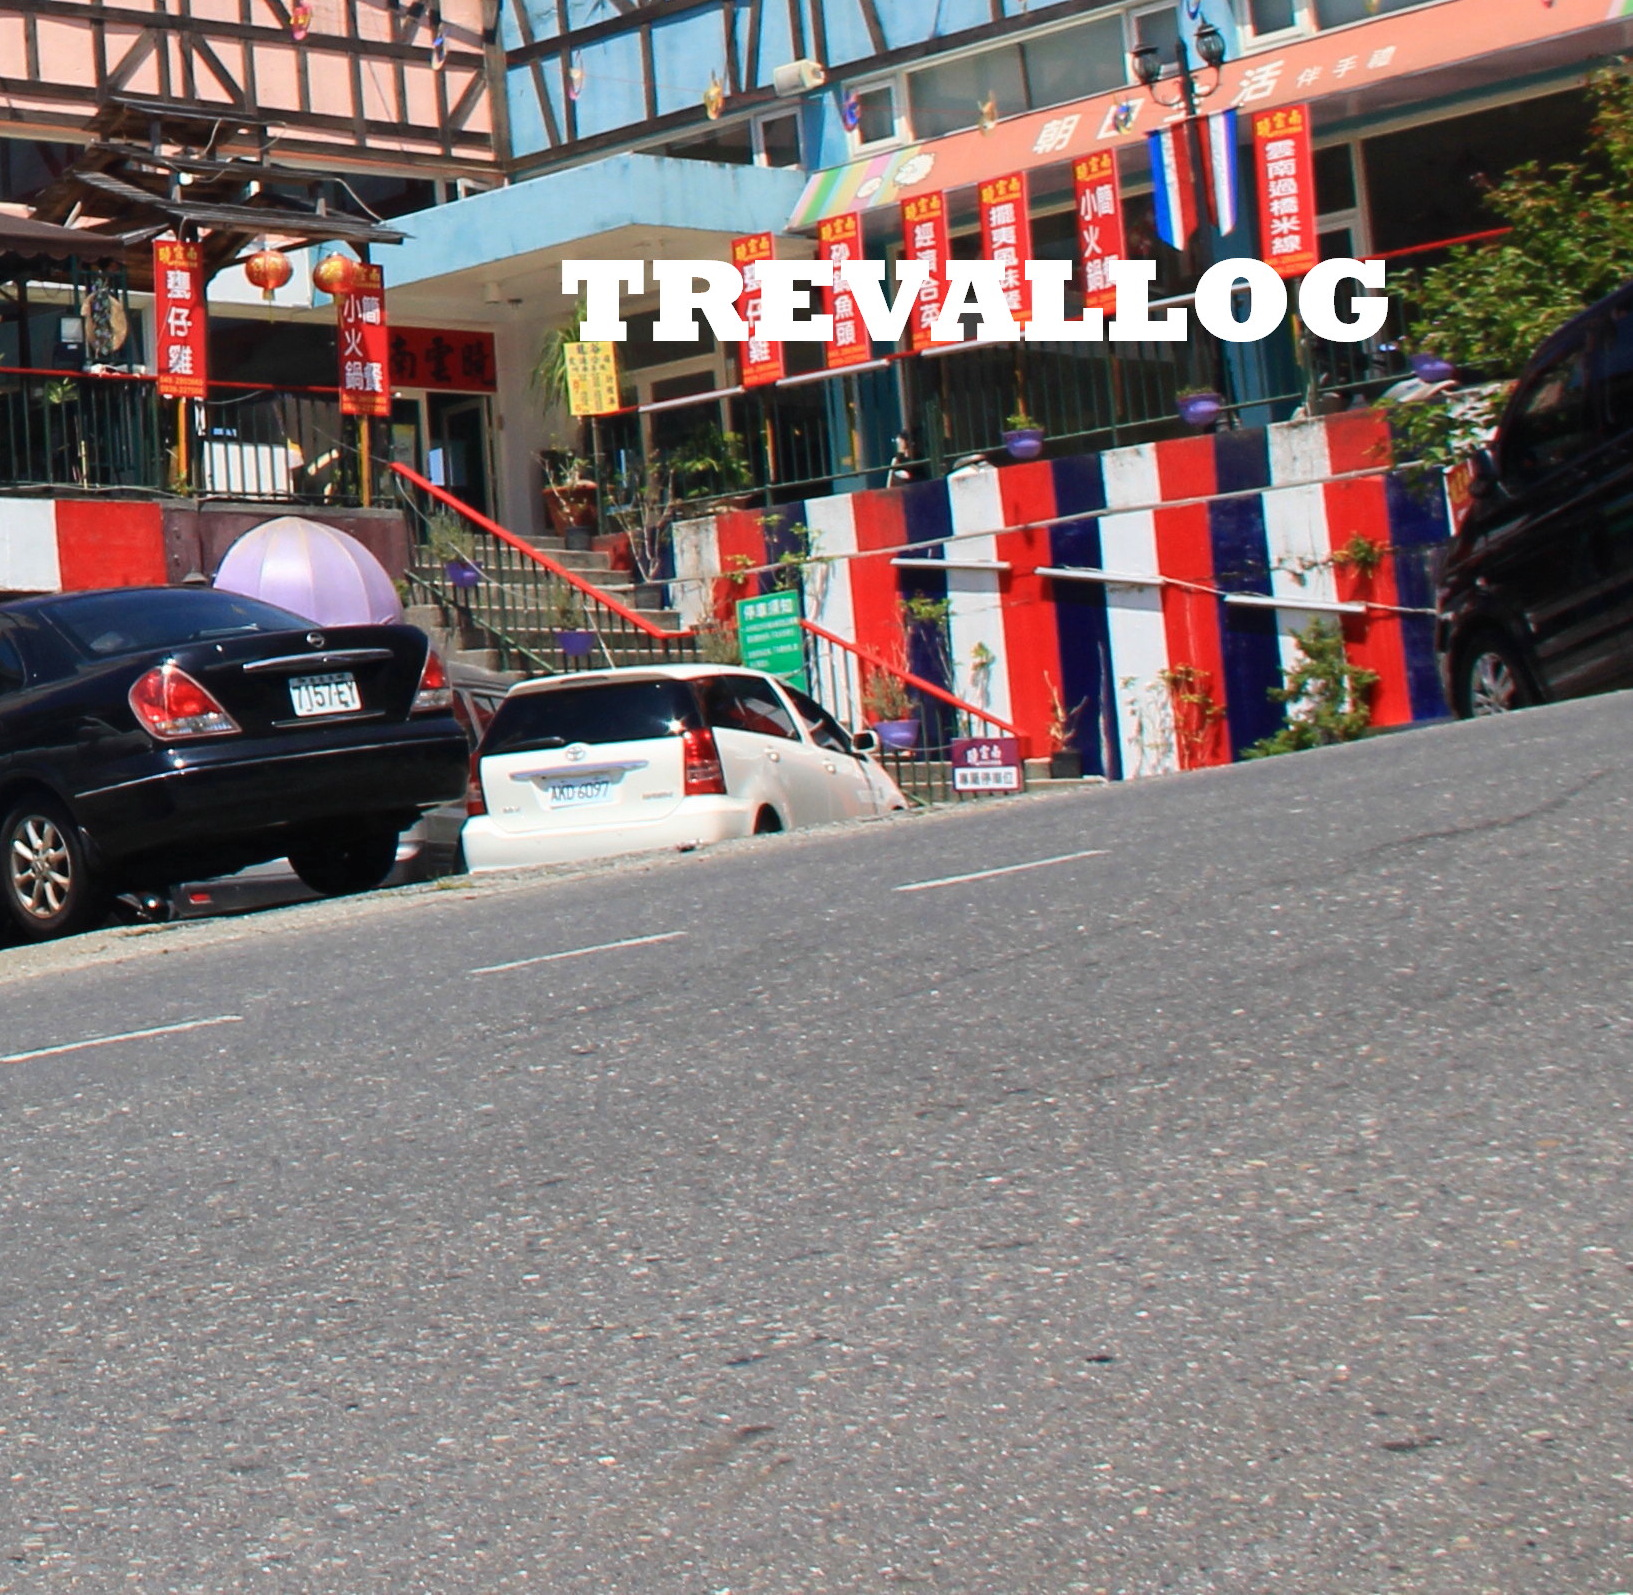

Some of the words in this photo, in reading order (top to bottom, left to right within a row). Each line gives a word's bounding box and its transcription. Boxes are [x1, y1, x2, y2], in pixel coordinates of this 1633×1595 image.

[1265, 138, 1302, 255] 雲南過橋米線
[343, 293, 365, 391] 小火鍋
[550, 780, 610, 802] AKD-6097
